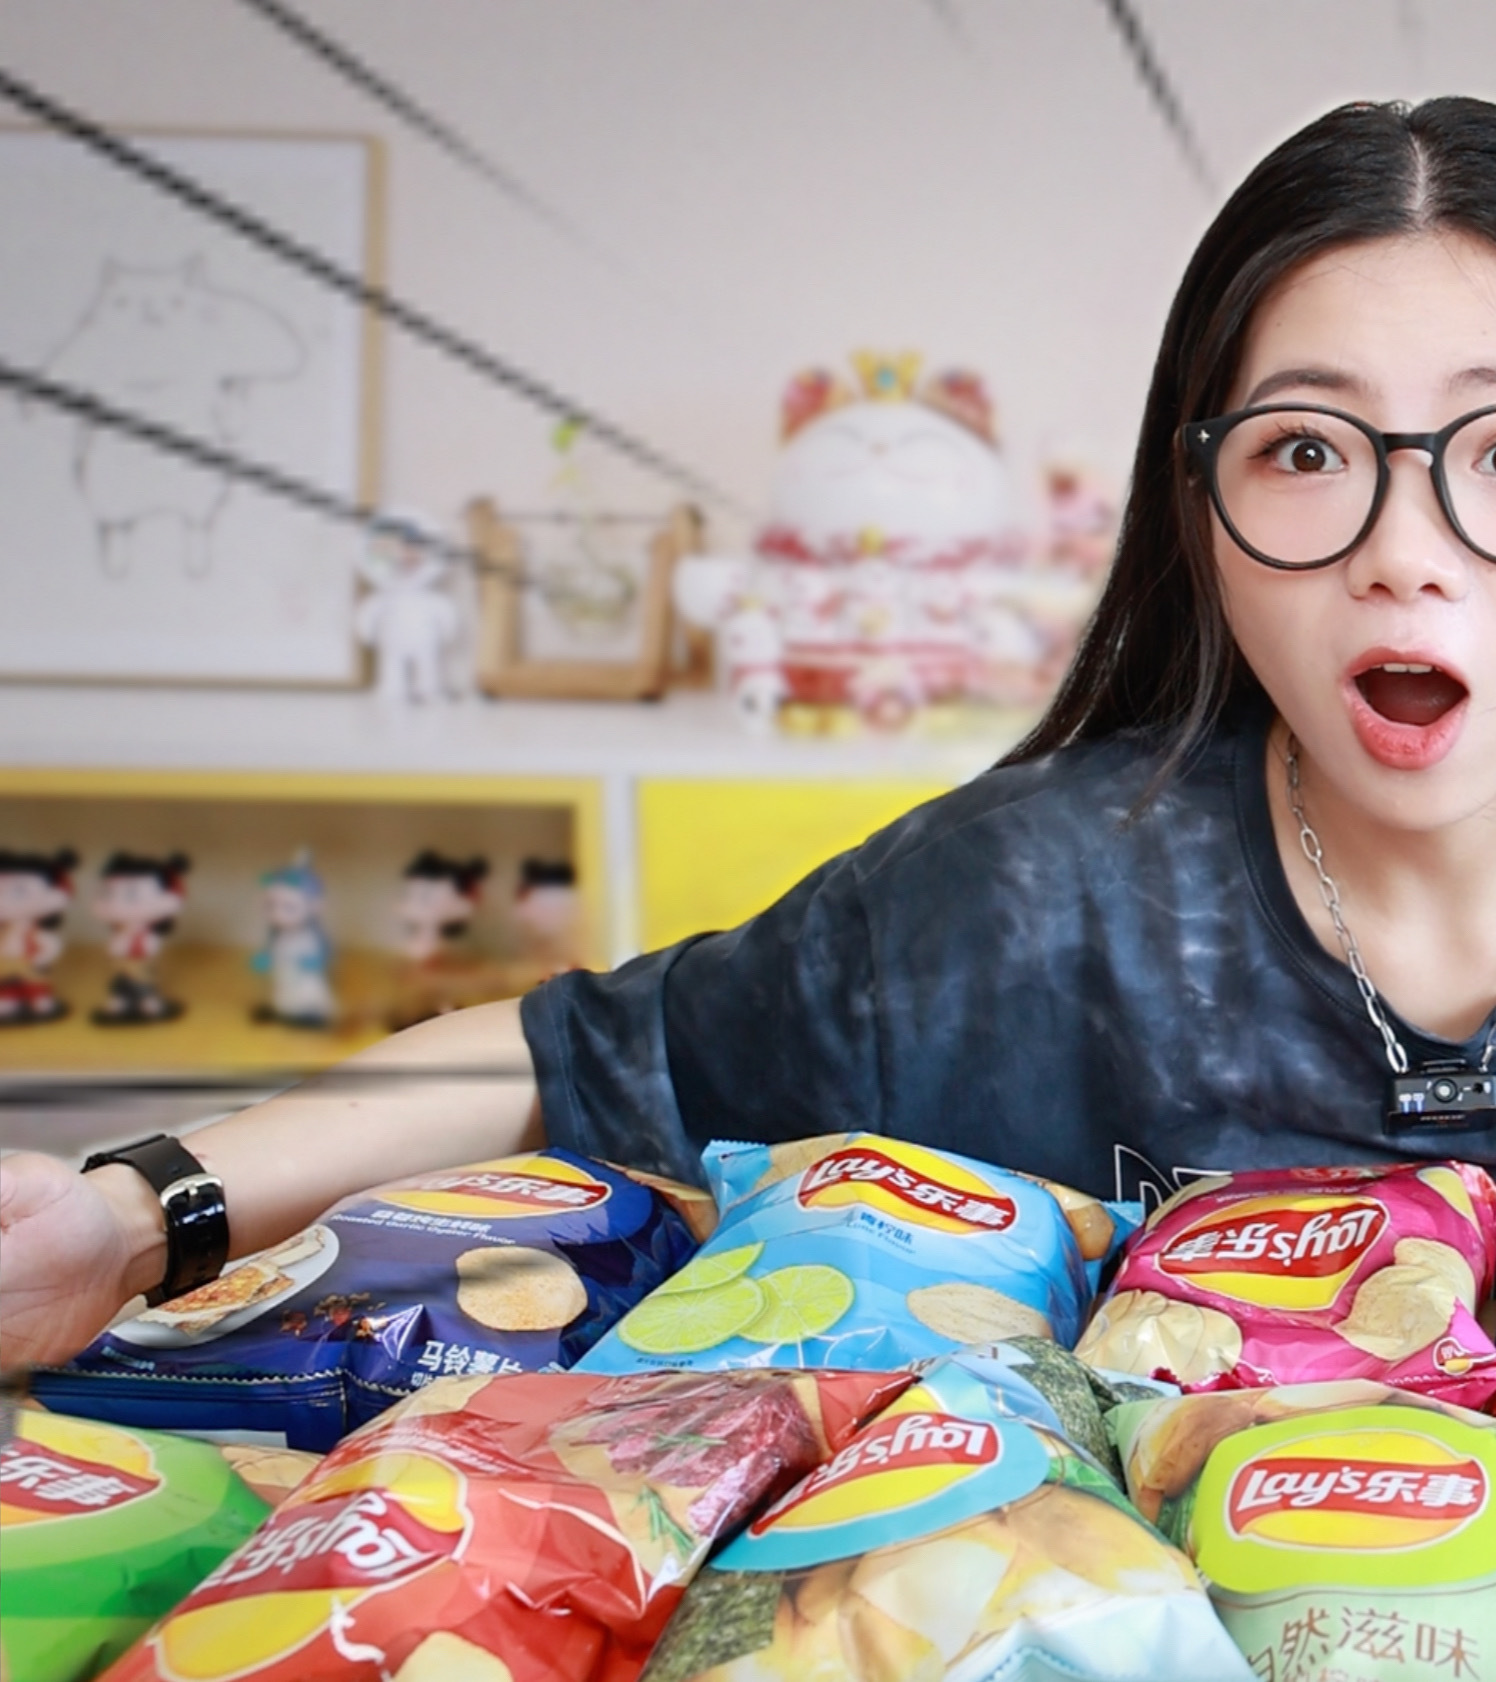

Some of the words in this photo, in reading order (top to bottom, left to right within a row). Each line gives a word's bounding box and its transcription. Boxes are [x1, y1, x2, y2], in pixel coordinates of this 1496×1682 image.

[806, 1156, 1012, 1226] Lay's乐事
[1164, 1208, 1380, 1267] Lay's乐事
[1237, 1467, 1479, 1511] Lay's乐事
